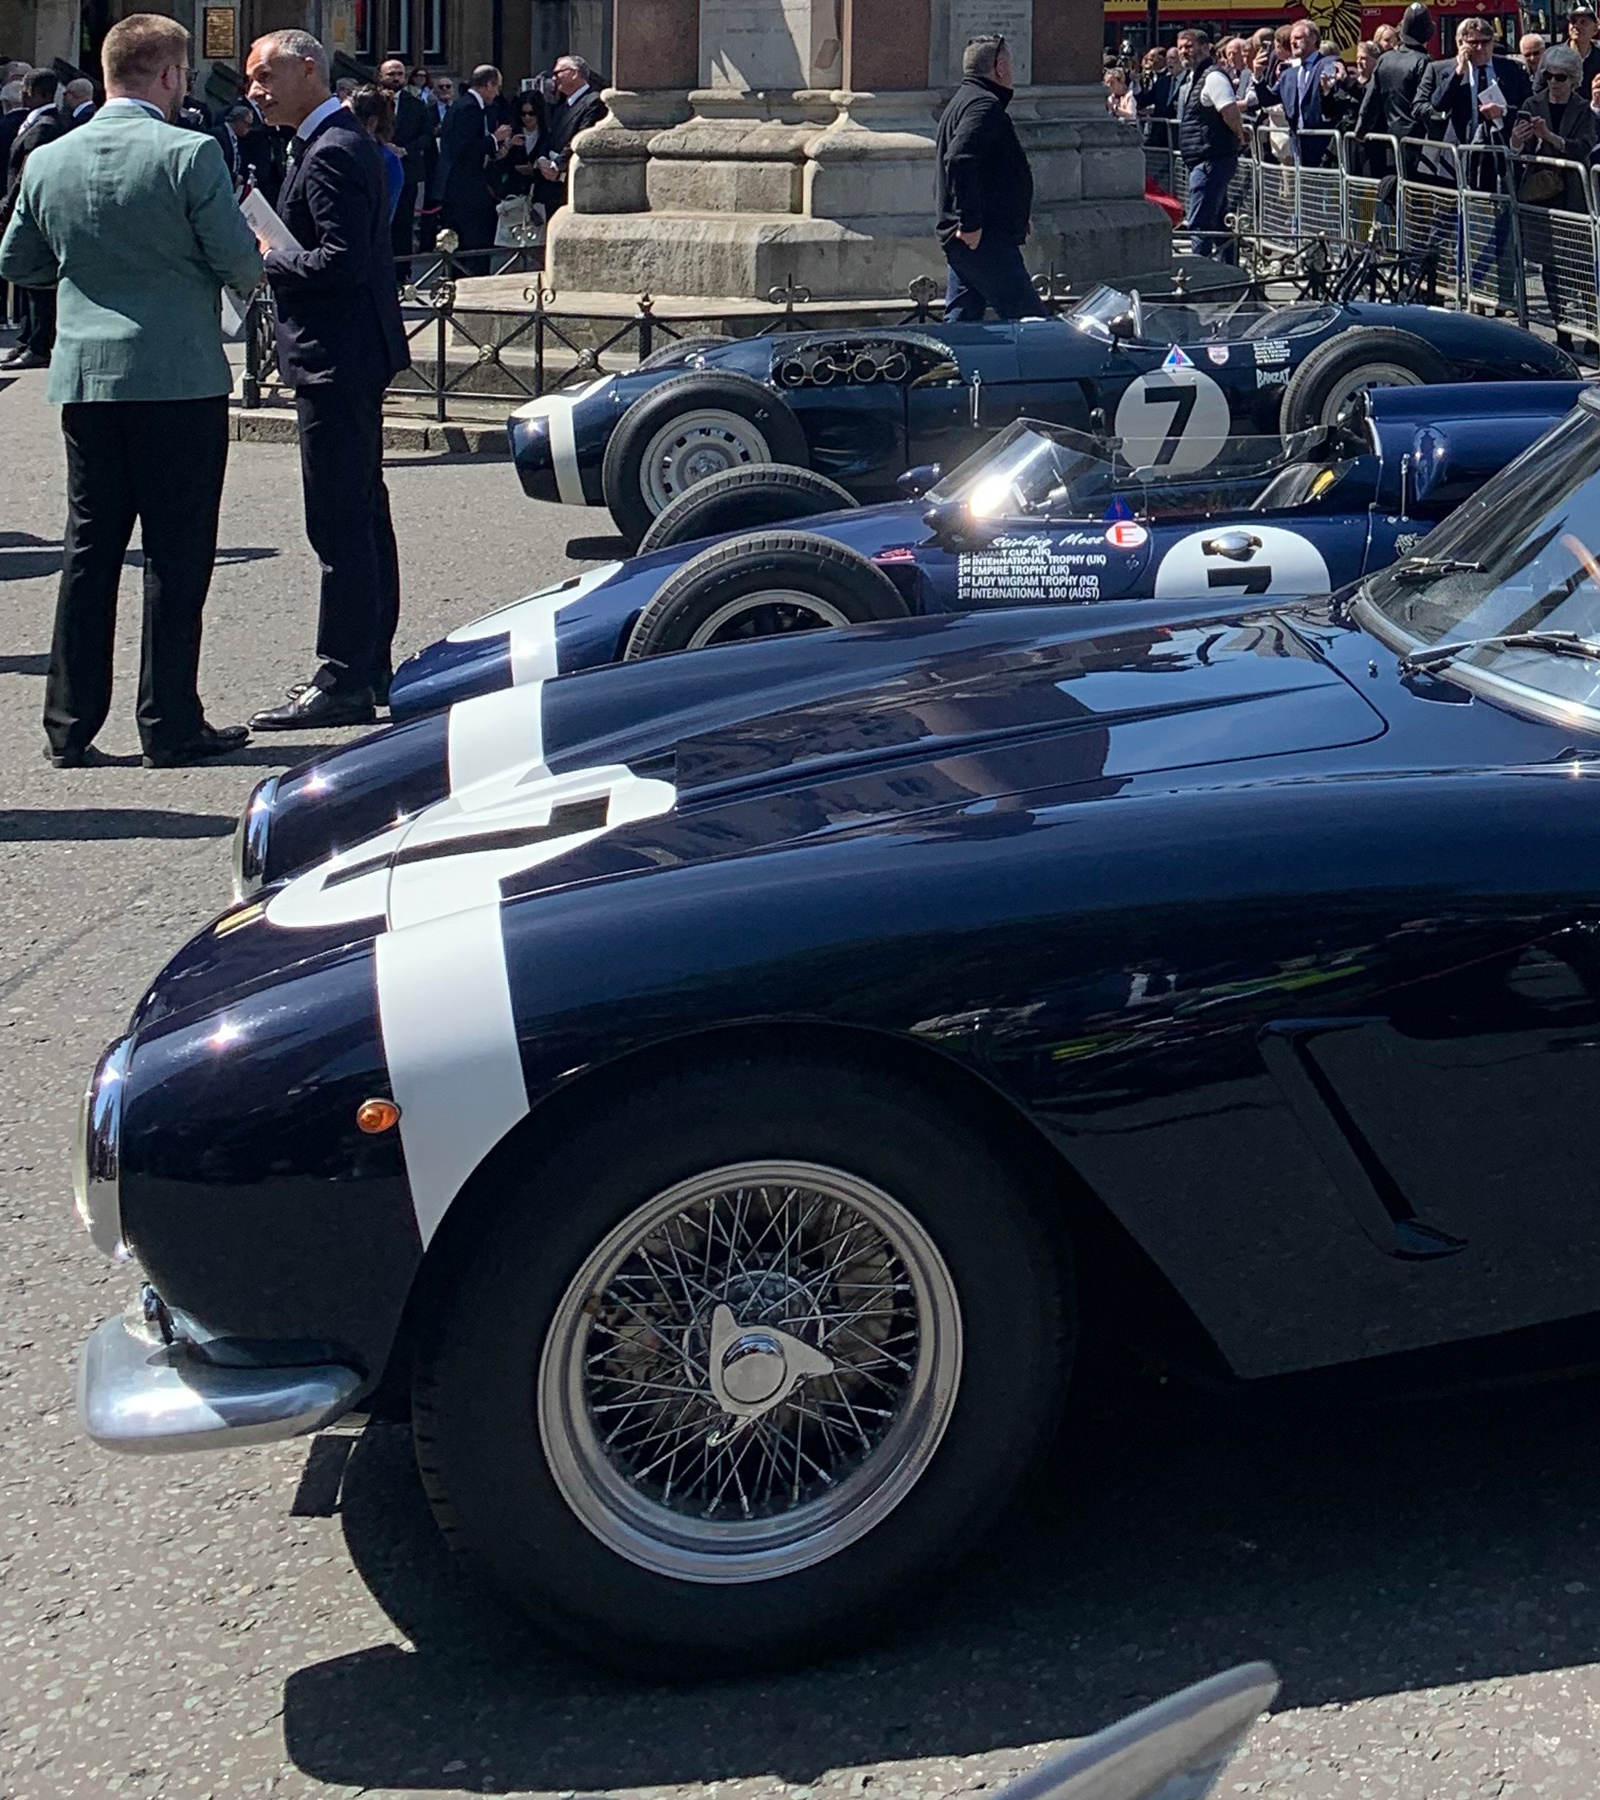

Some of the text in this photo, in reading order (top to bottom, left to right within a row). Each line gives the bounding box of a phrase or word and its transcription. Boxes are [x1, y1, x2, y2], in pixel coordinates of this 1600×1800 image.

[1145, 385, 1197, 465] 7
[989, 532, 1104, 550] Stirling Moss
[1115, 526, 1139, 543] E
[972, 549, 1007, 558] LAVANT
[1008, 549, 1029, 557] CUP
[1031, 548, 1051, 558] (UK)
[972, 556, 1046, 566] INTERNATIONAL
[1049, 554, 1085, 564] TROPHY
[1086, 554, 1107, 566] (UK)
[972, 565, 1009, 575] EMPIRE
[1011, 565, 1048, 575] TROPHY
[1049, 565, 1070, 576] (UK)
[972, 575, 997, 587] LADY
[997, 575, 1039, 586] WIGRAM
[1041, 575, 1078, 586] TROPHY
[1079, 575, 1099, 587] (NZ)
[971, 587, 1046, 599] INTERNATIONAL
[1048, 587, 1067, 598] 100
[1068, 586, 1100, 600] (AUST)
